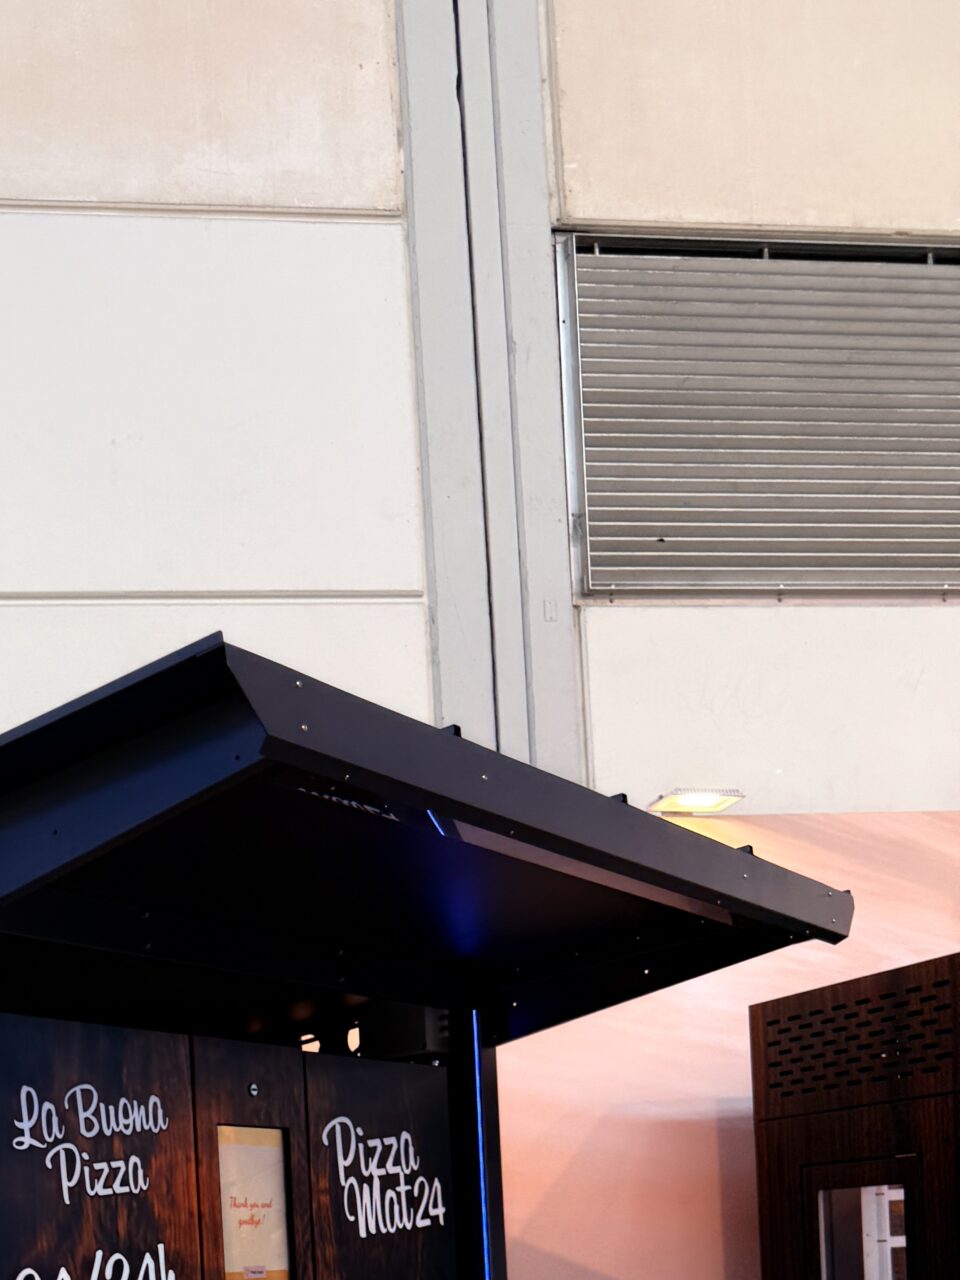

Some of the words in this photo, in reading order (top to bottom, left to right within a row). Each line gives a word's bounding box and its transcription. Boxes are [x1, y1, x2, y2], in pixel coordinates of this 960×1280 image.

[12, 1085, 65, 1150] La
[64, 1083, 169, 1138] Buona
[45, 1142, 149, 1205] Pizza
[322, 1116, 420, 1187] Pizza
[230, 1196, 249, 1209] Thank
[250, 1201, 260, 1211] you
[261, 1198, 273, 1209] and
